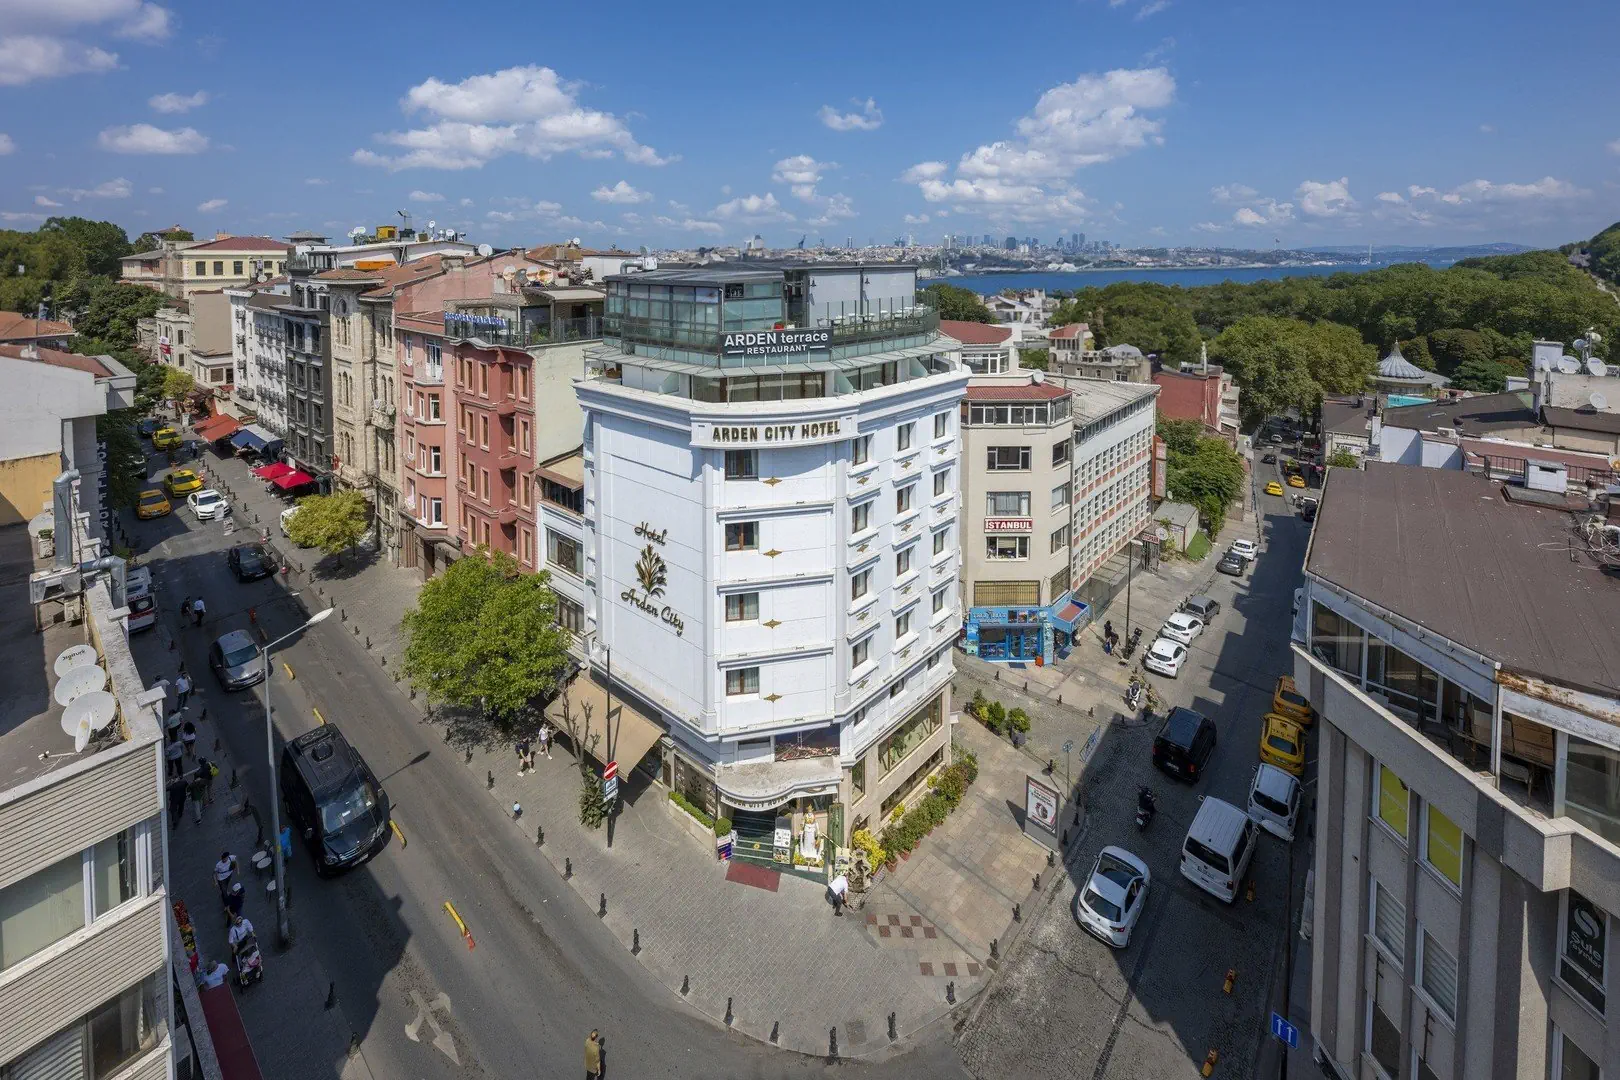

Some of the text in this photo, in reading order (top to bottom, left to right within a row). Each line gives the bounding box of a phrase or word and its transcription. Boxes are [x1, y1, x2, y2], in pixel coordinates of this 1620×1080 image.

[724, 332, 828, 347] ARDEN terrace
[746, 344, 807, 355] RESTAURANT
[712, 421, 841, 441] ARDEN CITY HOTEL
[634, 521, 667, 546] Hotel
[620, 588, 684, 637] Arden City
